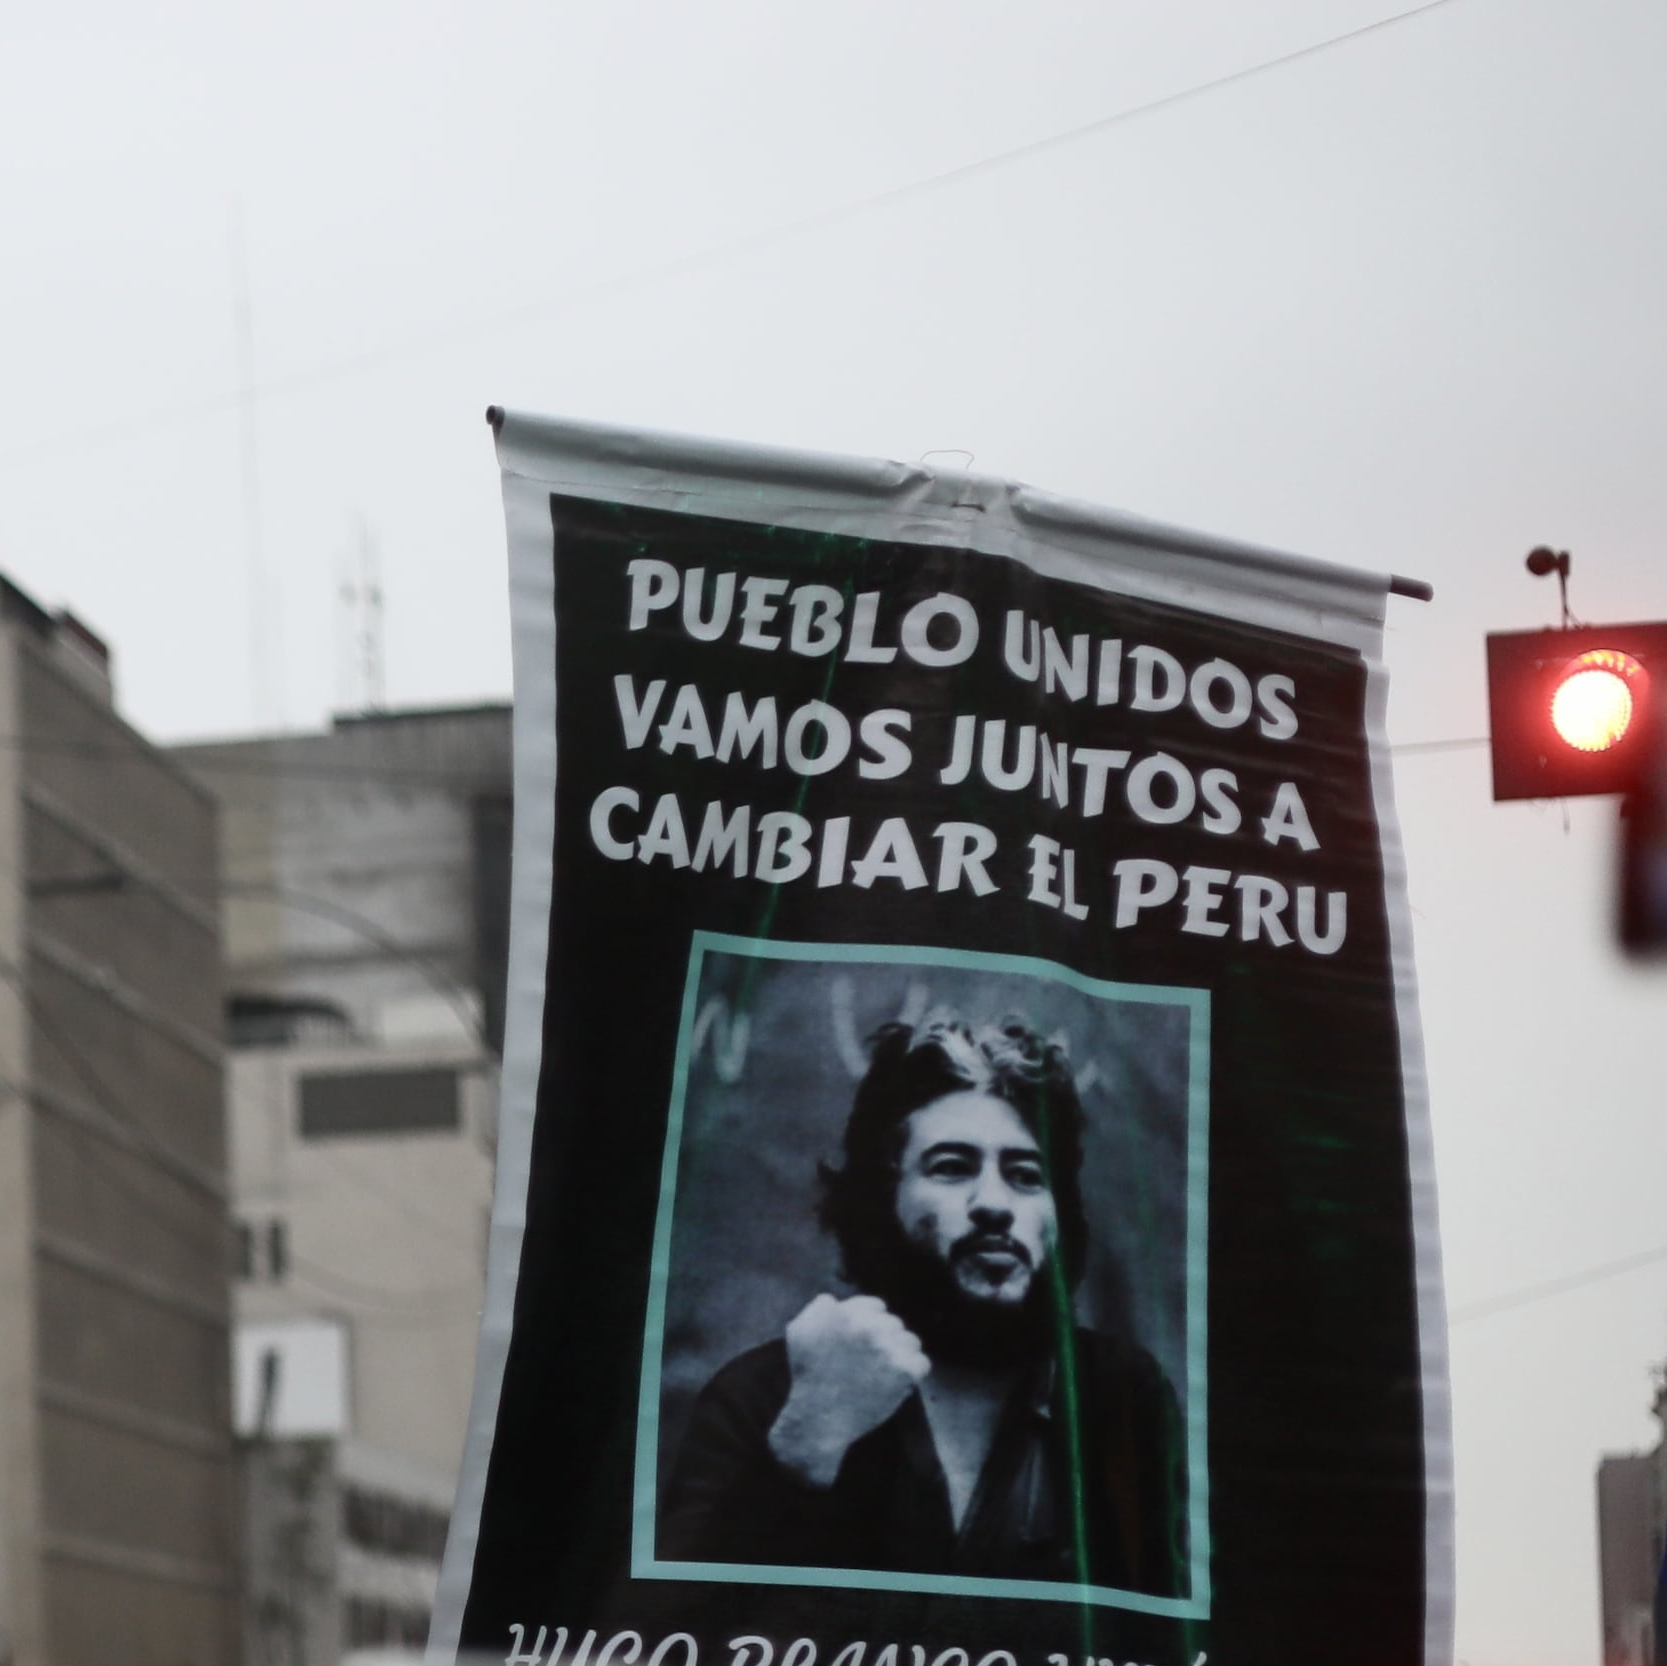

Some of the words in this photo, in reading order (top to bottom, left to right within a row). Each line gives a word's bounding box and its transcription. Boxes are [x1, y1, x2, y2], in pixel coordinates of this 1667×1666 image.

[625, 559, 980, 667] PUEBLO
[1004, 609, 1298, 741] UNIDOS
[614, 674, 913, 780] VAMOS
[940, 715, 1242, 835] JUNTOS
[1262, 782, 1320, 852] A
[589, 785, 1001, 897] CAMBIAR
[1027, 834, 1090, 920] EL
[1112, 858, 1348, 955] PERU
